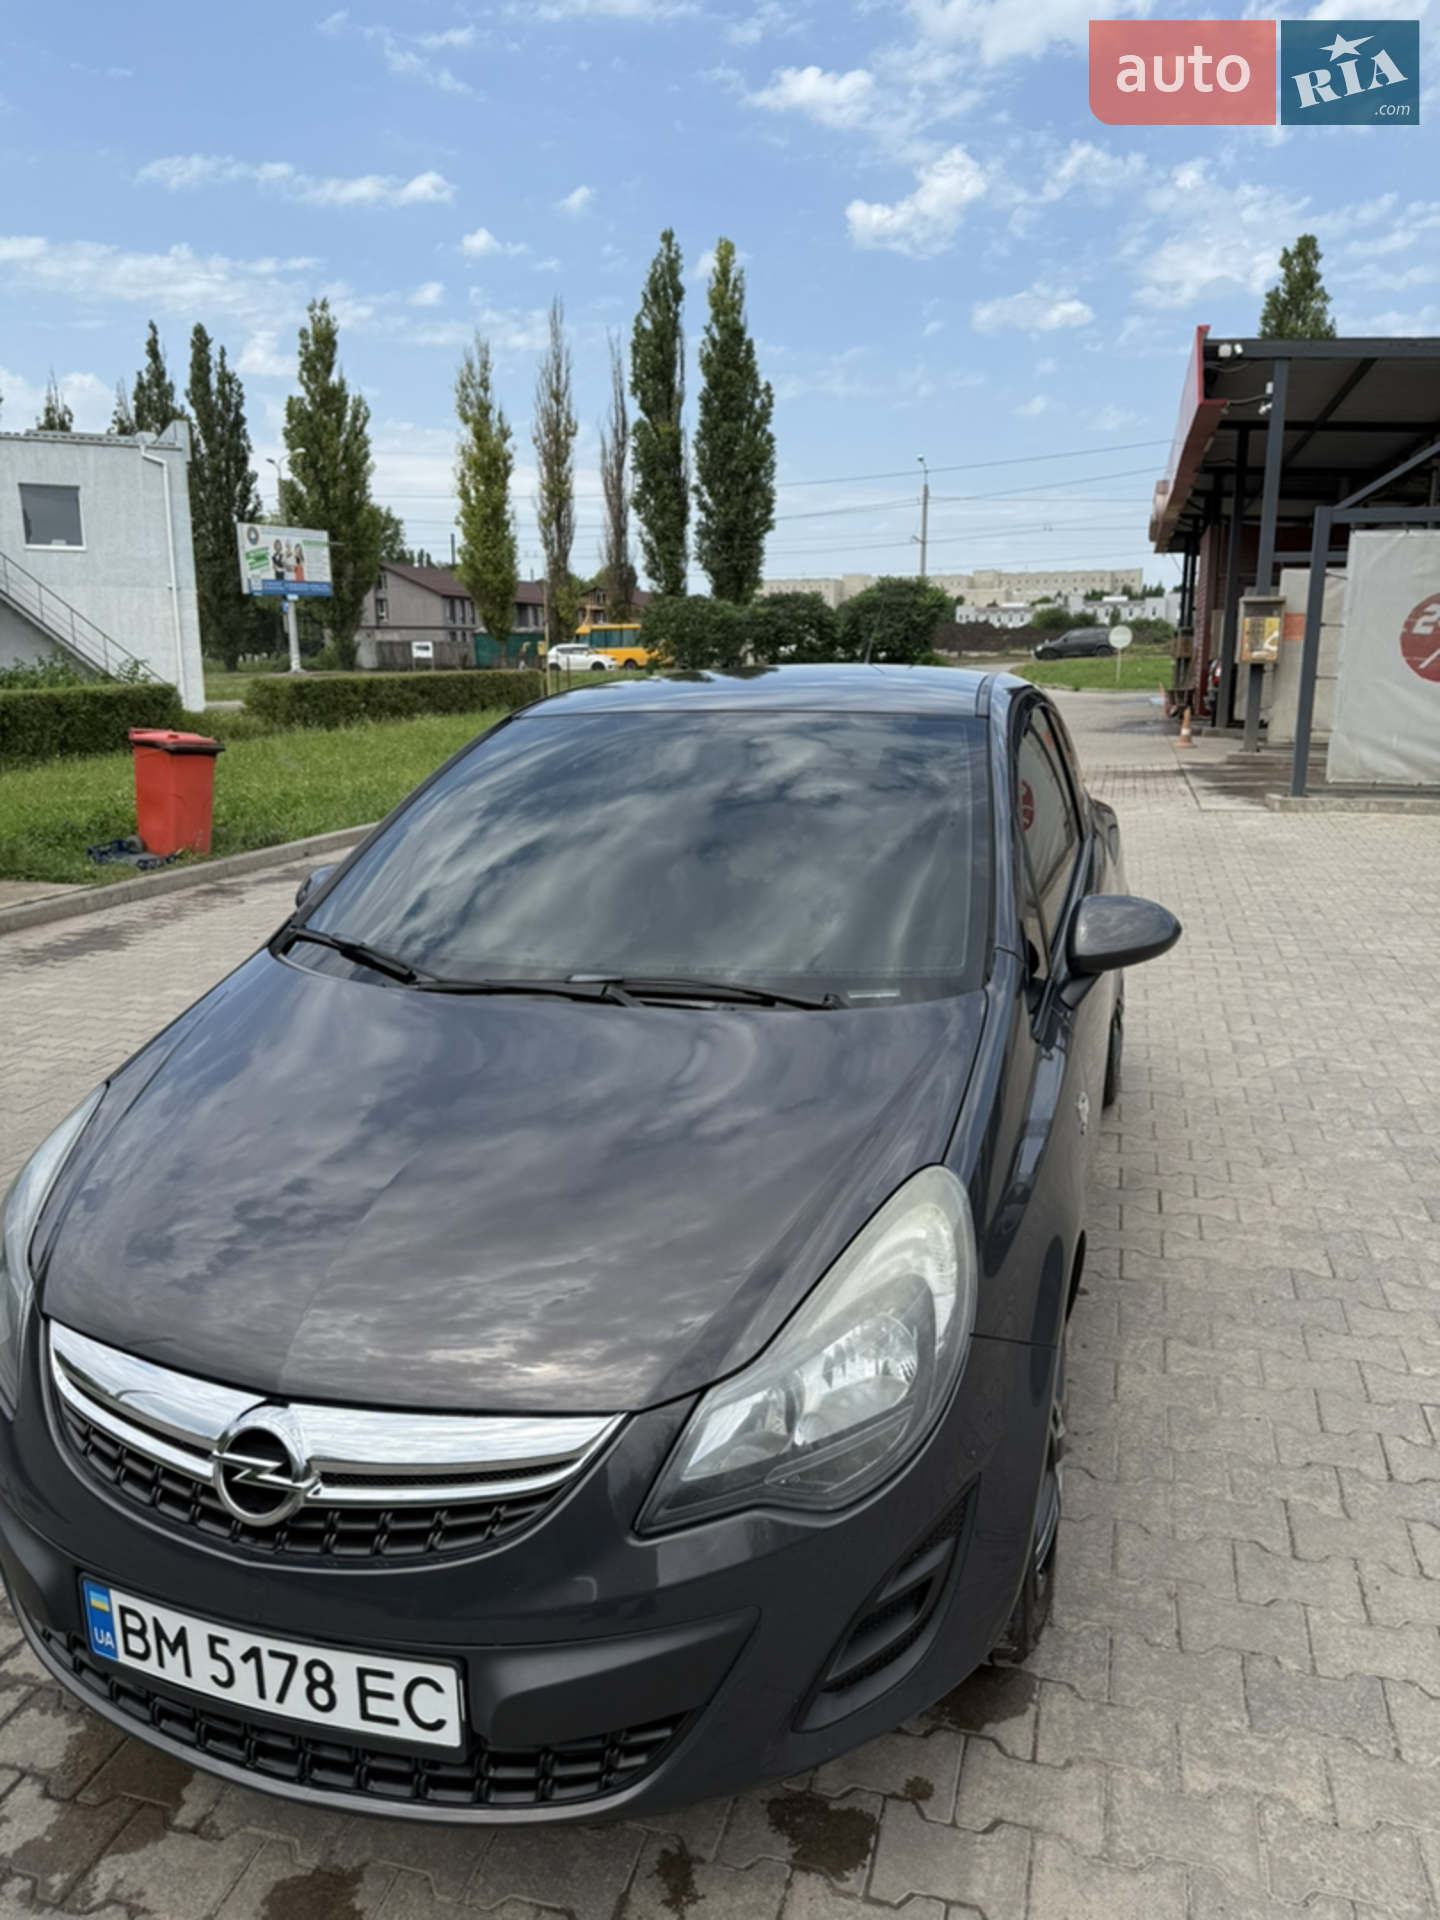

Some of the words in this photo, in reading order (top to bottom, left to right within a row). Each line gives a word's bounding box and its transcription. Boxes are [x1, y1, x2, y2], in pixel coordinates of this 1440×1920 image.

[93, 1626, 116, 1649] UA
[118, 1604, 192, 1679] BM
[207, 1633, 337, 1713] 5178
[356, 1667, 448, 1732] EC
